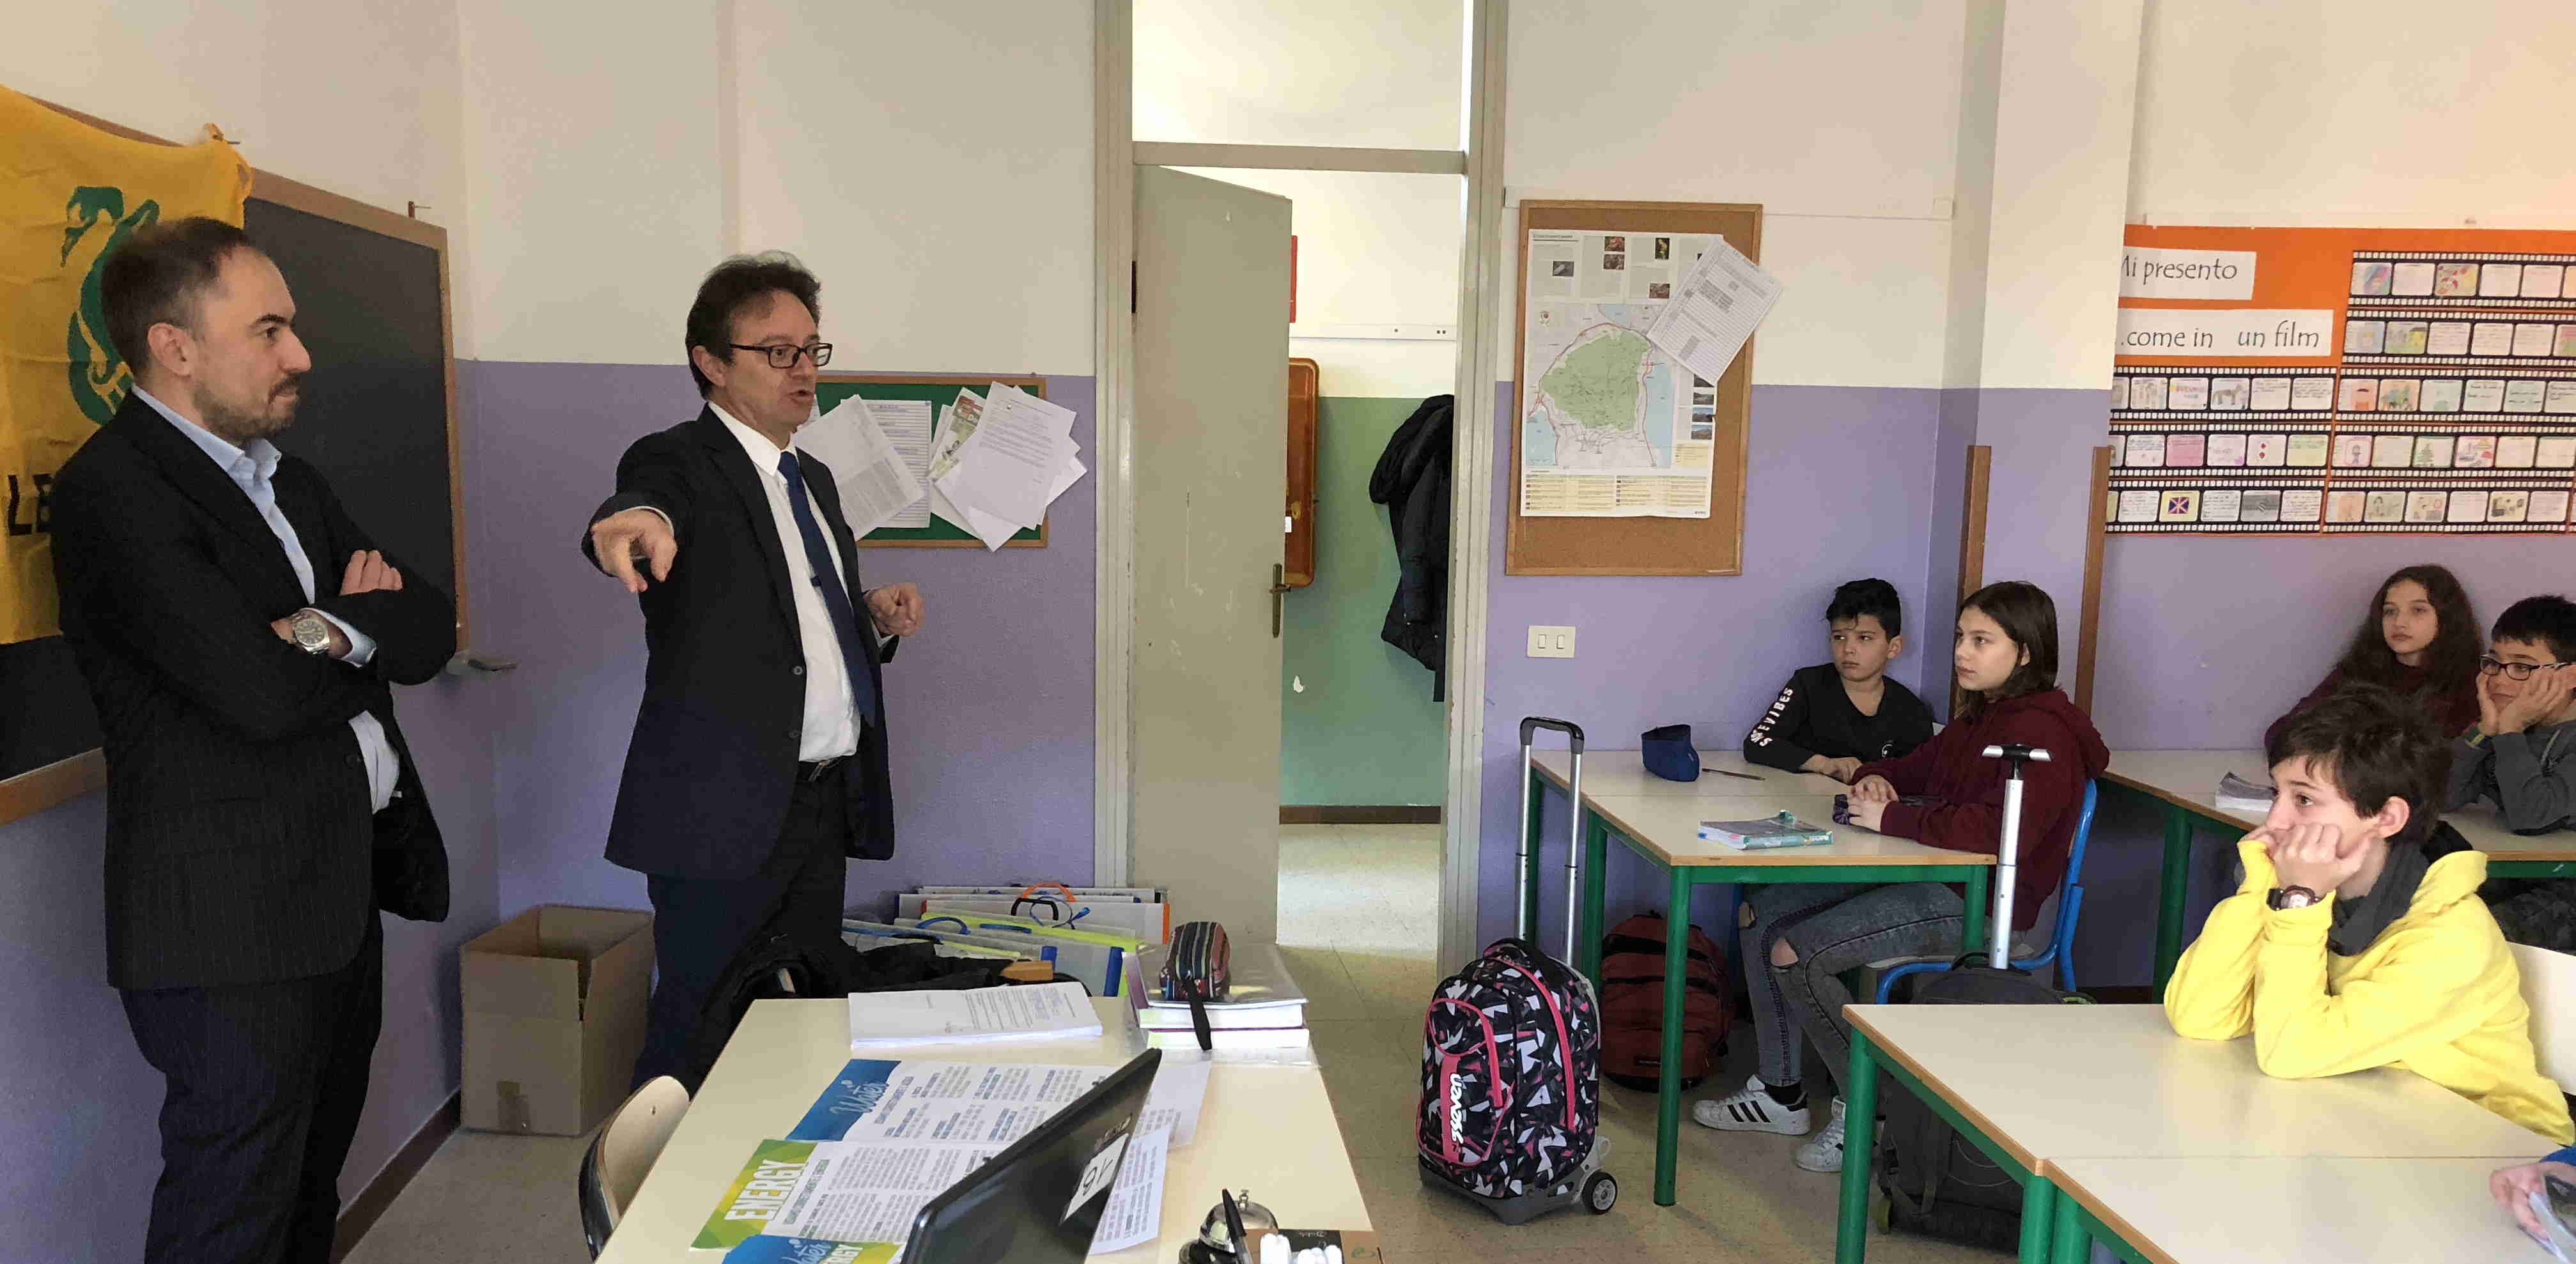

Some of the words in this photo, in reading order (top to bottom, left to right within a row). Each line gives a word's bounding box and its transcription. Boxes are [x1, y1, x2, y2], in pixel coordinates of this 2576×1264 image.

[2143, 258, 2237, 285] presento
[2193, 328, 2213, 348] in
[2238, 331, 2265, 348] un
[2275, 320, 2319, 348] film
[829, 1081, 889, 1114] Water
[724, 1159, 809, 1221] ENERGY
